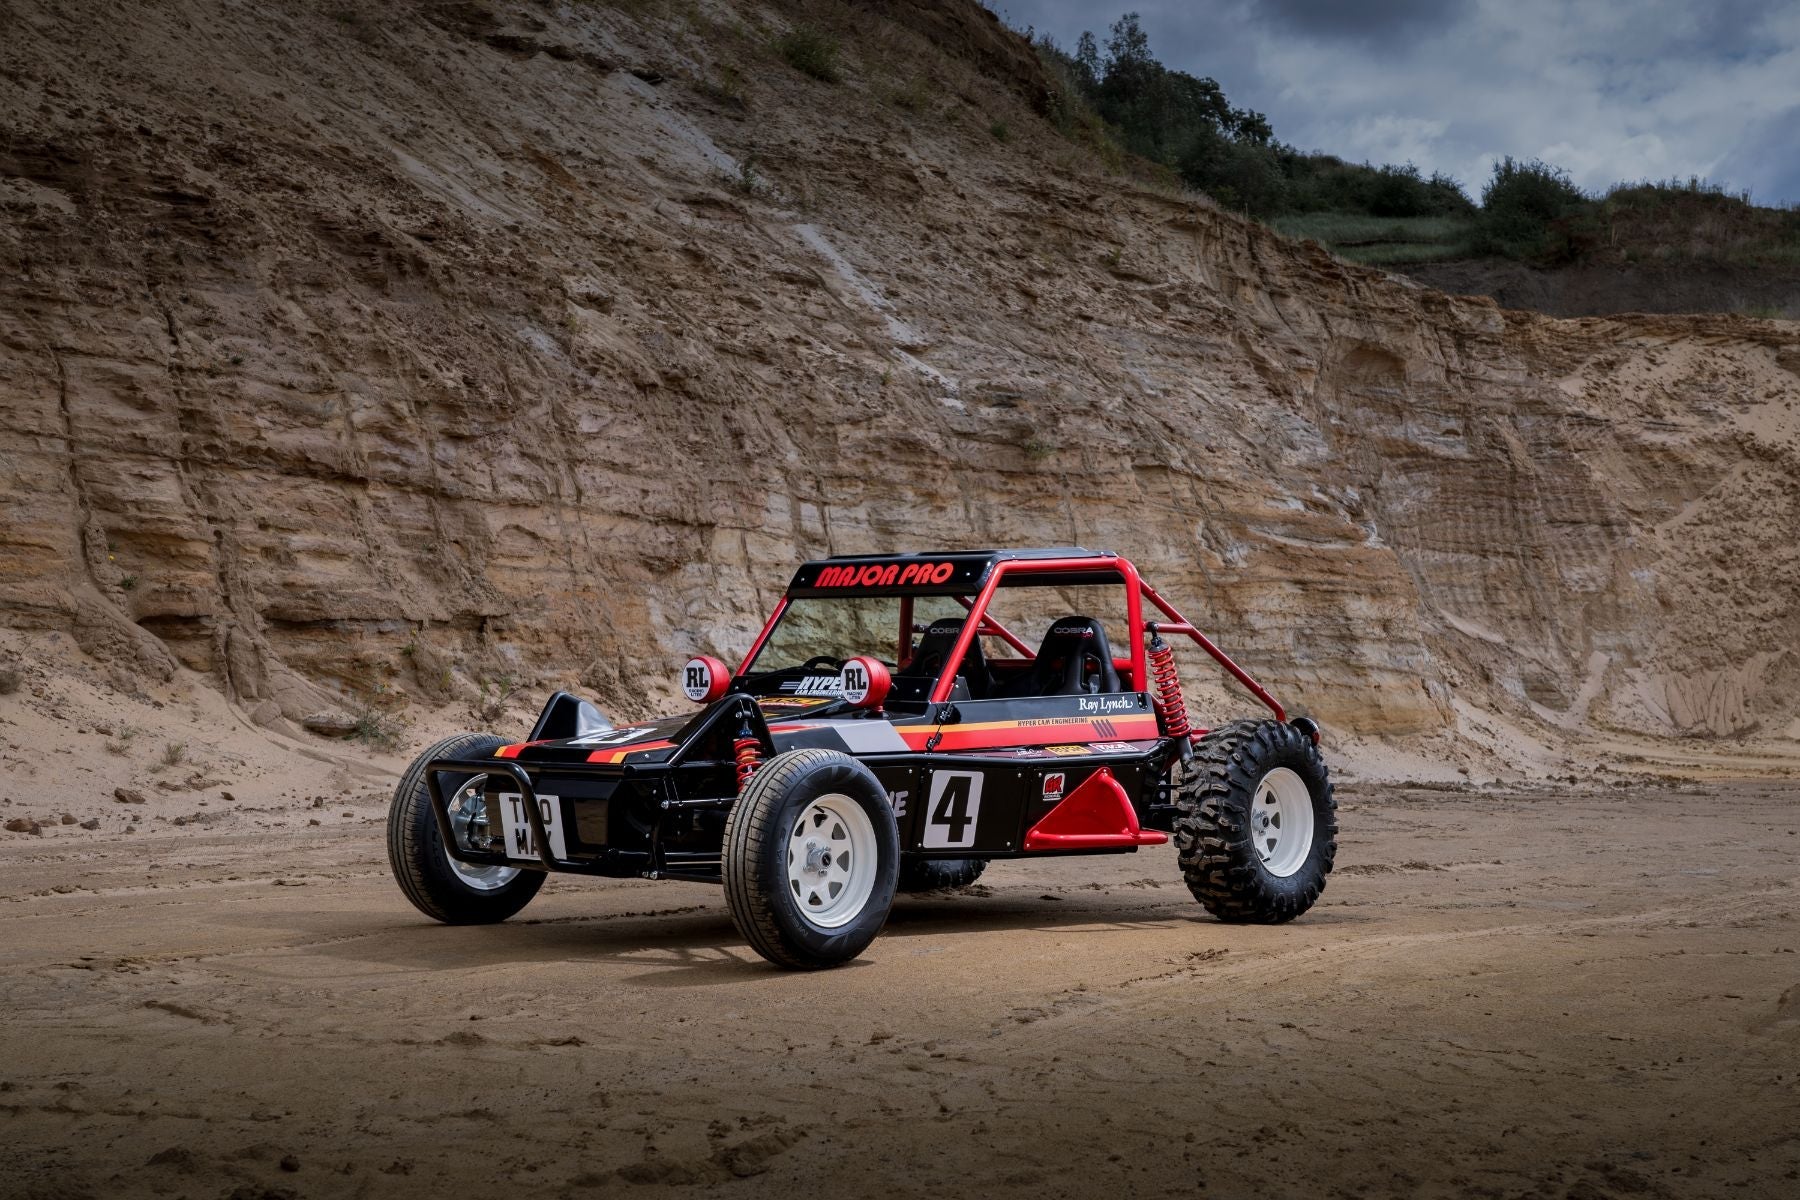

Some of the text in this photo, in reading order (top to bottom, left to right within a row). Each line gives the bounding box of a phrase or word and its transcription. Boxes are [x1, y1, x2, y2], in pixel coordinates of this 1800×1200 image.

[814, 562, 954, 588] MAJOR PRO
[930, 627, 961, 635] COBR
[1053, 626, 1094, 634] COBRA
[686, 667, 709, 688] RL
[797, 676, 841, 690] HYPE
[844, 668, 867, 691] RL
[1079, 696, 1134, 713] Ray Lynch
[1017, 719, 1037, 727] HYPER
[508, 796, 553, 826] TO
[931, 775, 973, 843] 4
[514, 828, 552, 856] MA
